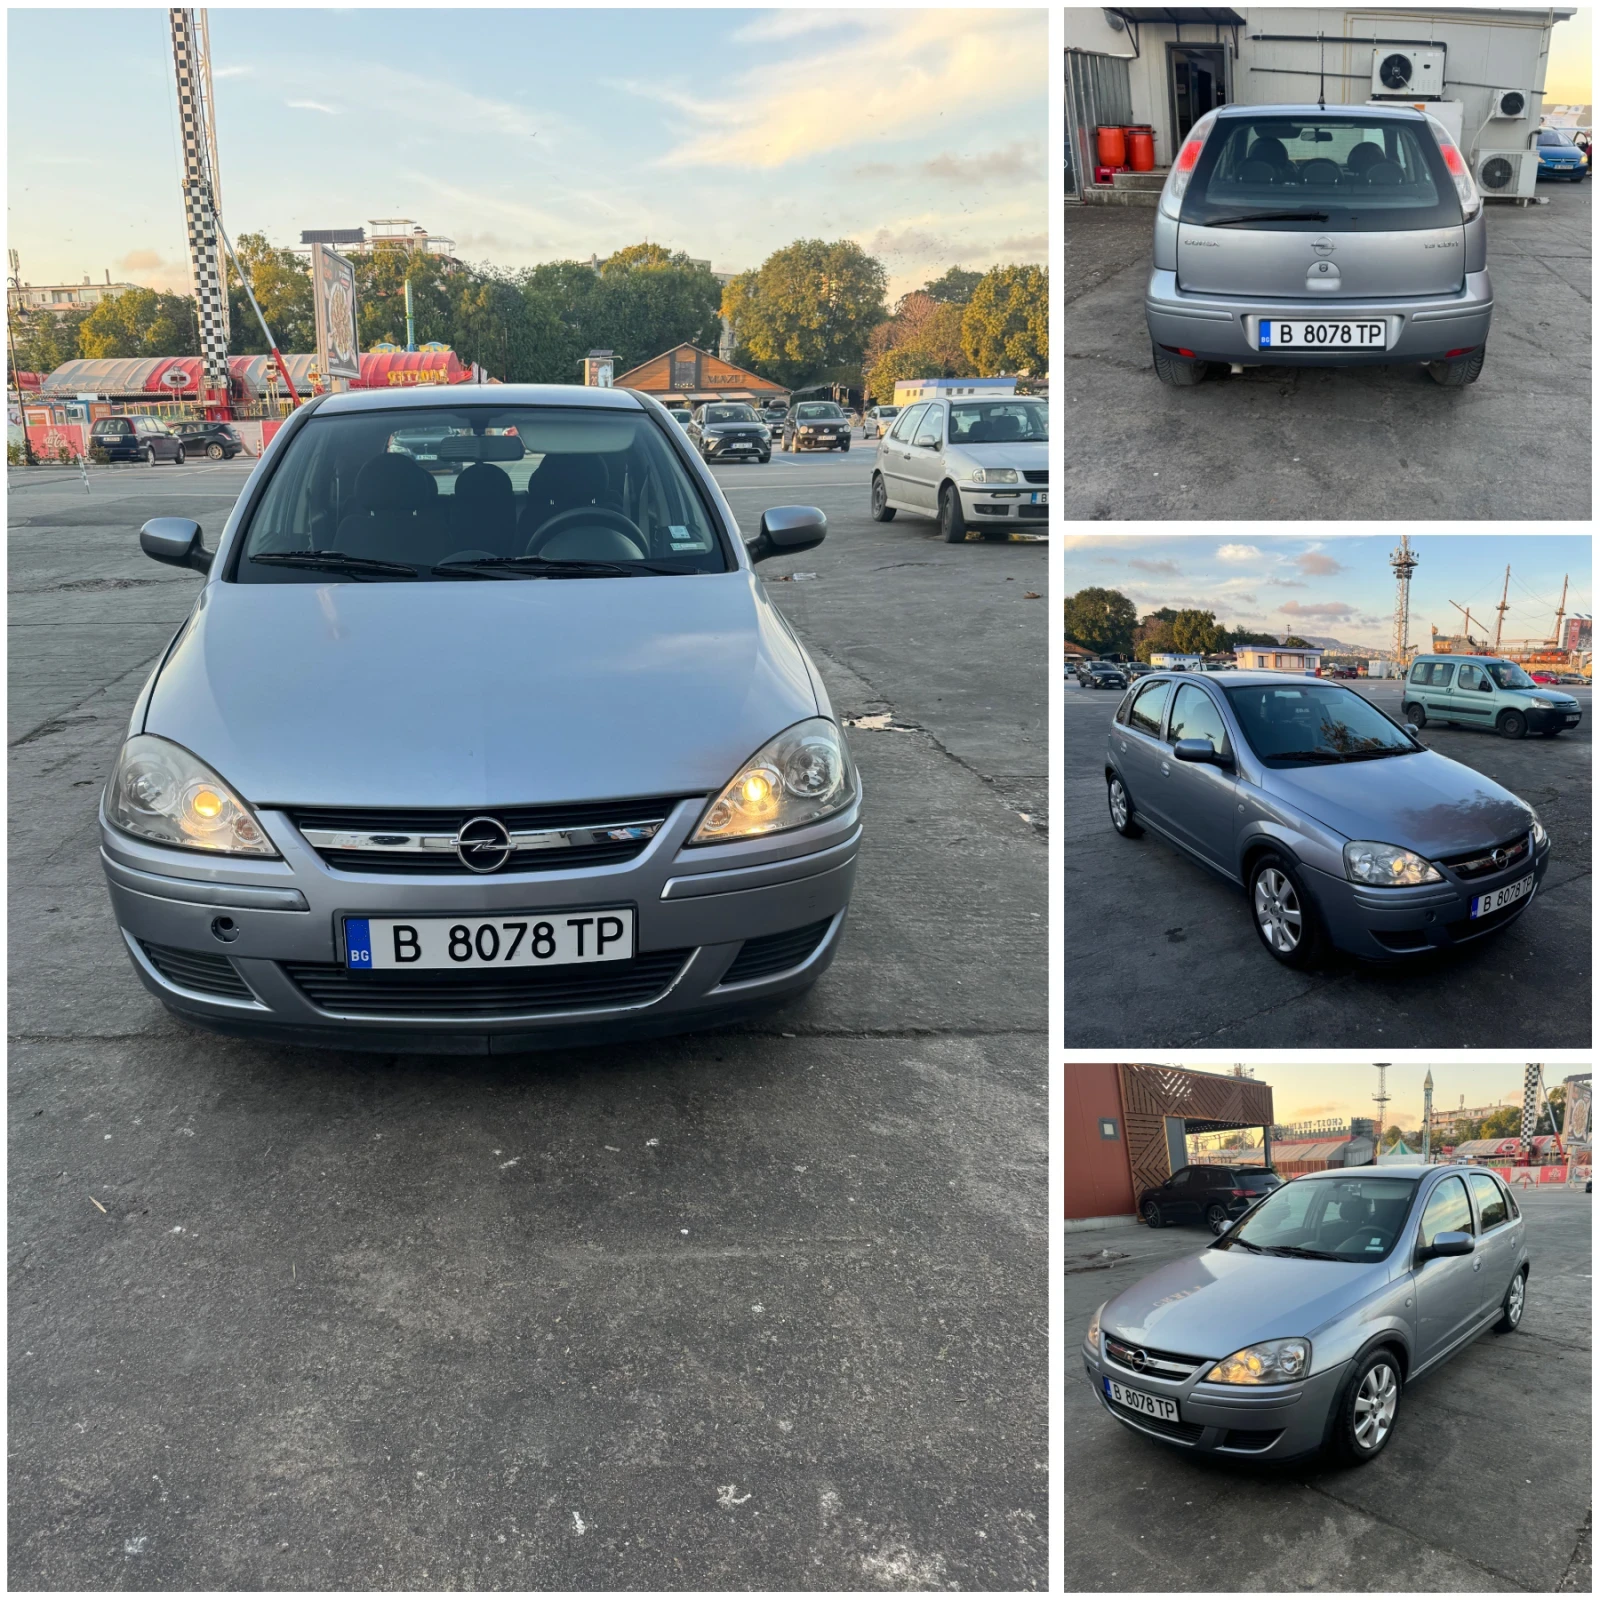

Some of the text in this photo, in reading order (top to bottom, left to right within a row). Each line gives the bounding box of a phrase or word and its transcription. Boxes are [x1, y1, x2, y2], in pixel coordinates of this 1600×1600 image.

[1280, 324, 1381, 343] B 8078 TP
[1483, 876, 1533, 912] B 8078 TP
[351, 950, 369, 962] BG
[393, 916, 624, 963] B 8078 TP
[1113, 1384, 1175, 1418] B 8078 TP
